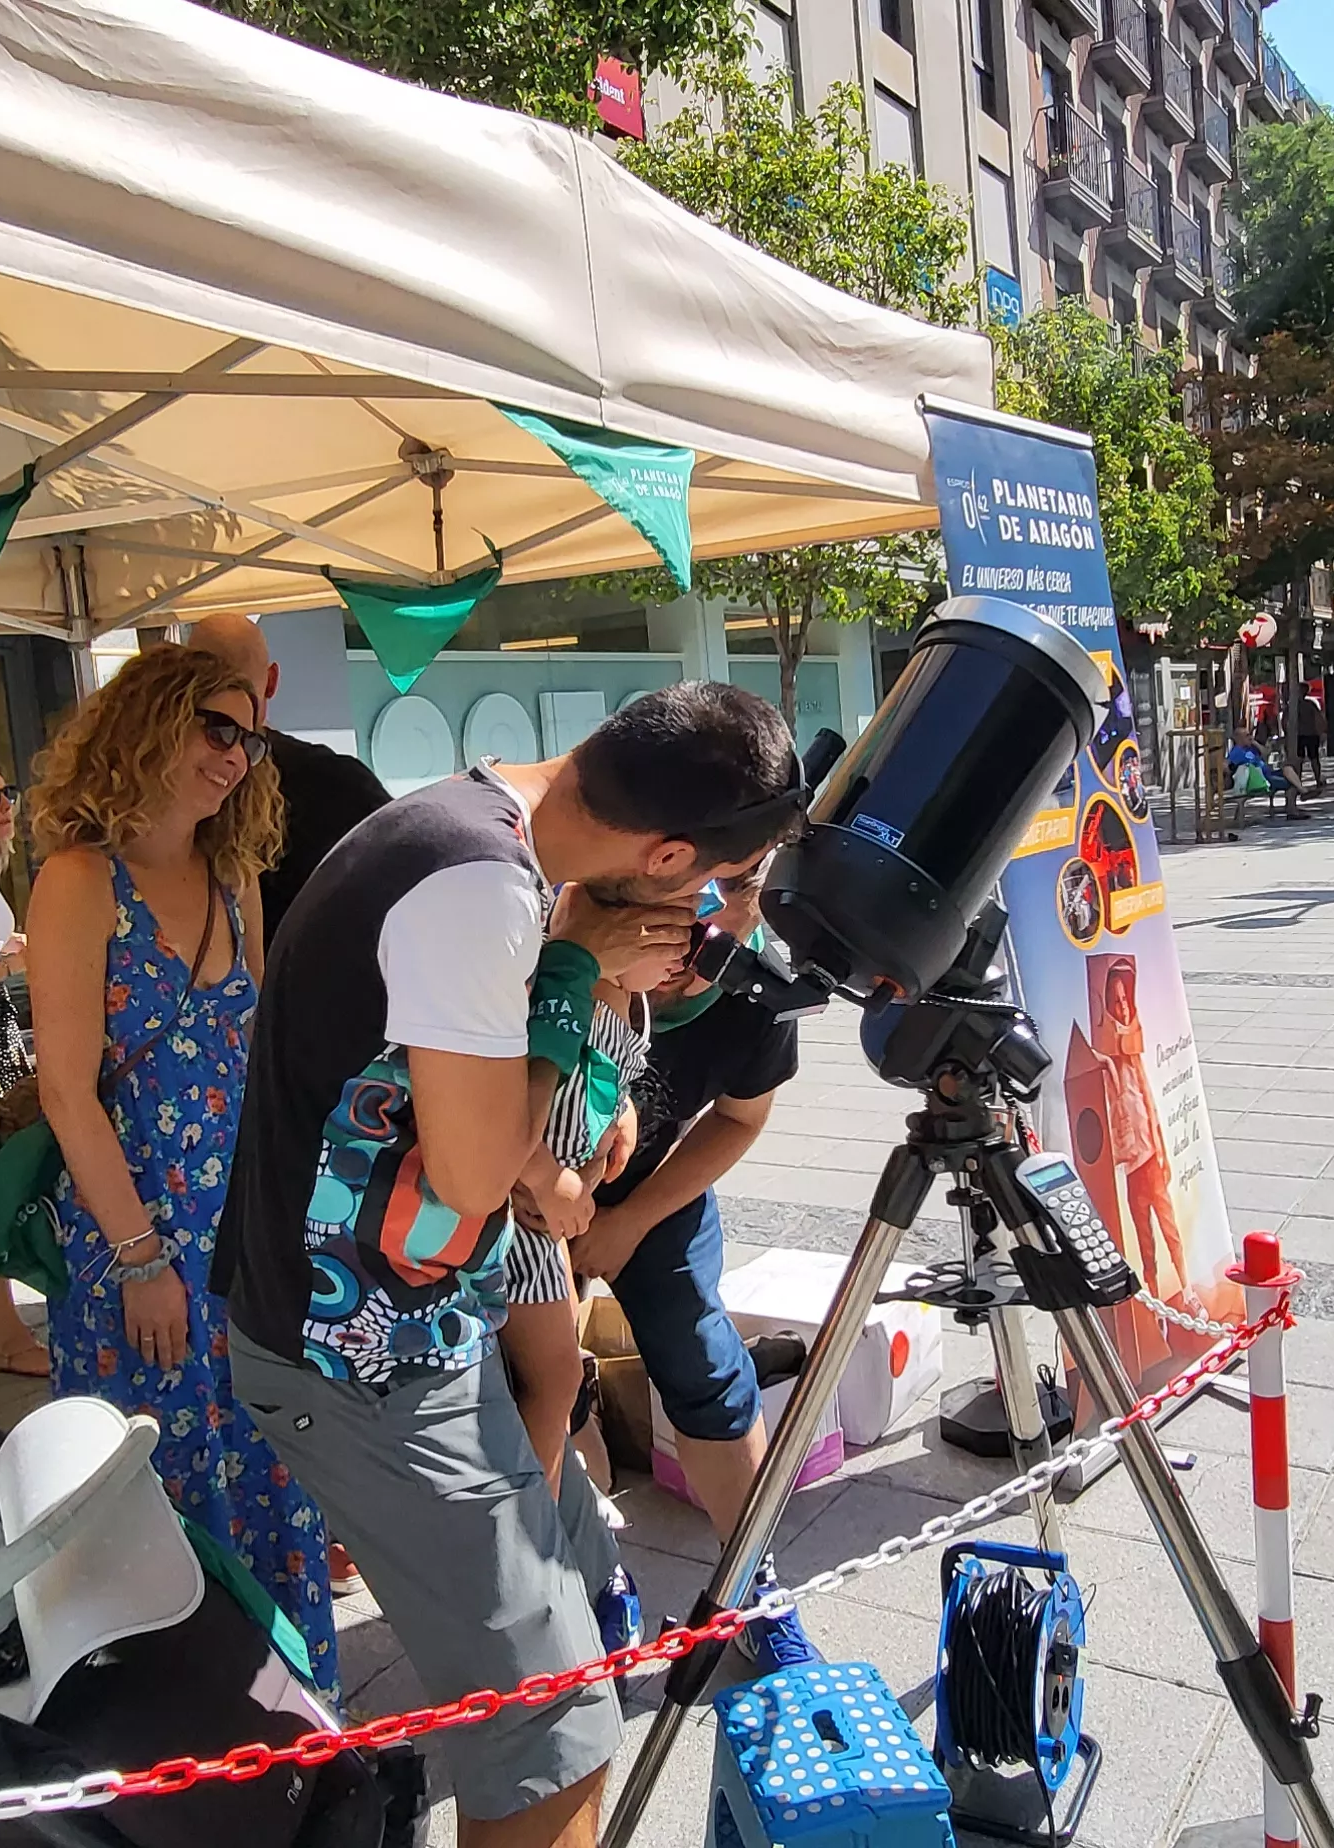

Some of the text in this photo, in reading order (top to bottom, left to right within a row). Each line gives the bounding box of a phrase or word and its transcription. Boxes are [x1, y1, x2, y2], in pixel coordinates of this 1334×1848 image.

[992, 478, 1093, 520] PLANETARIO
[998, 514, 1095, 550] DE ARAGÓN
[962, 564, 1072, 593] EL UNIVERSO MÁS CERCA
[1066, 605, 1078, 626] TE
[879, 831, 899, 844] XLT
